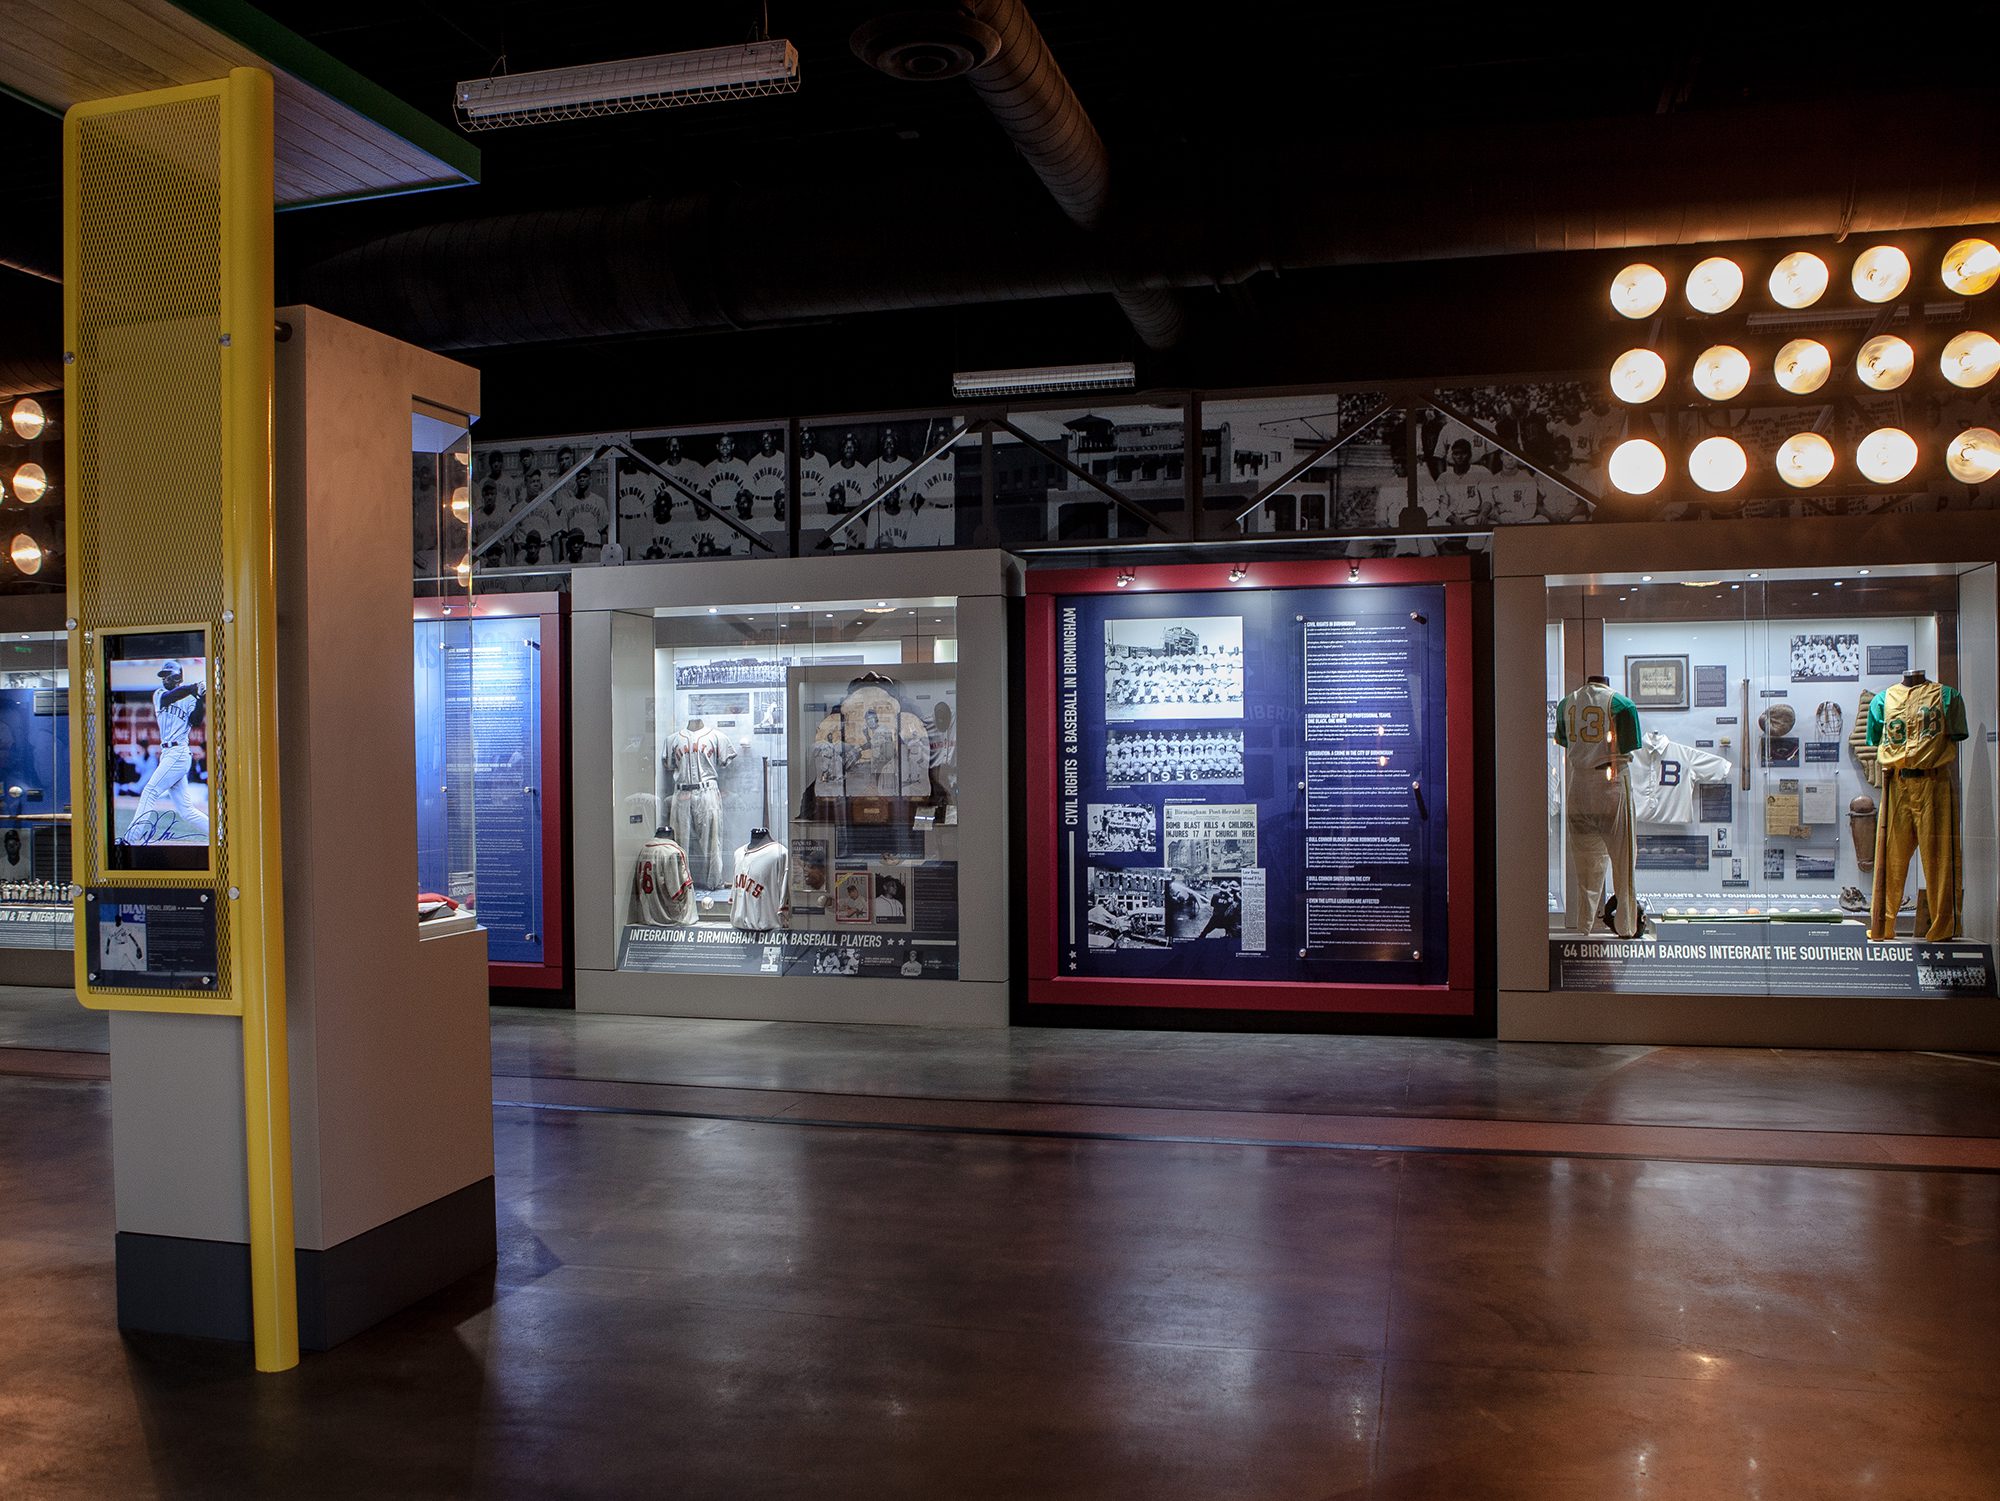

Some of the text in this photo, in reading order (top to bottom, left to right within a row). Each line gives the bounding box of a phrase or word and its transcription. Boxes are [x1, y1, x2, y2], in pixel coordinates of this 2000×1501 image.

[1063, 607, 1079, 825] CIVIL RIGHTS & BASEBALL IN BIRMINGHAM
[1568, 704, 1605, 743] 13
[1659, 760, 1681, 786] B
[1165, 821, 1180, 829] BOMB
[1184, 821, 1200, 829] BLAST
[1204, 821, 1218, 829] KILLS
[1221, 821, 1226, 829] 4
[1166, 830, 1255, 838] INJURES 17 AT CHURCH HERE
[9, 910, 16, 920] &
[16, 910, 31, 922] THE
[30, 911, 74, 922] INTEGRATION
[630, 929, 882, 947] INTEGRATION & BIRMINGHAM BLACK BASEBALL PLAYERS
[1580, 944, 1656, 958] BIRMINGHAM
[1659, 944, 1706, 959] BARONS
[1710, 945, 1772, 960] INTEGRATE
[1774, 946, 1796, 960] THE
[1800, 946, 1863, 961] SOUTHERN
[1867, 948, 1913, 962] LEAGUE
